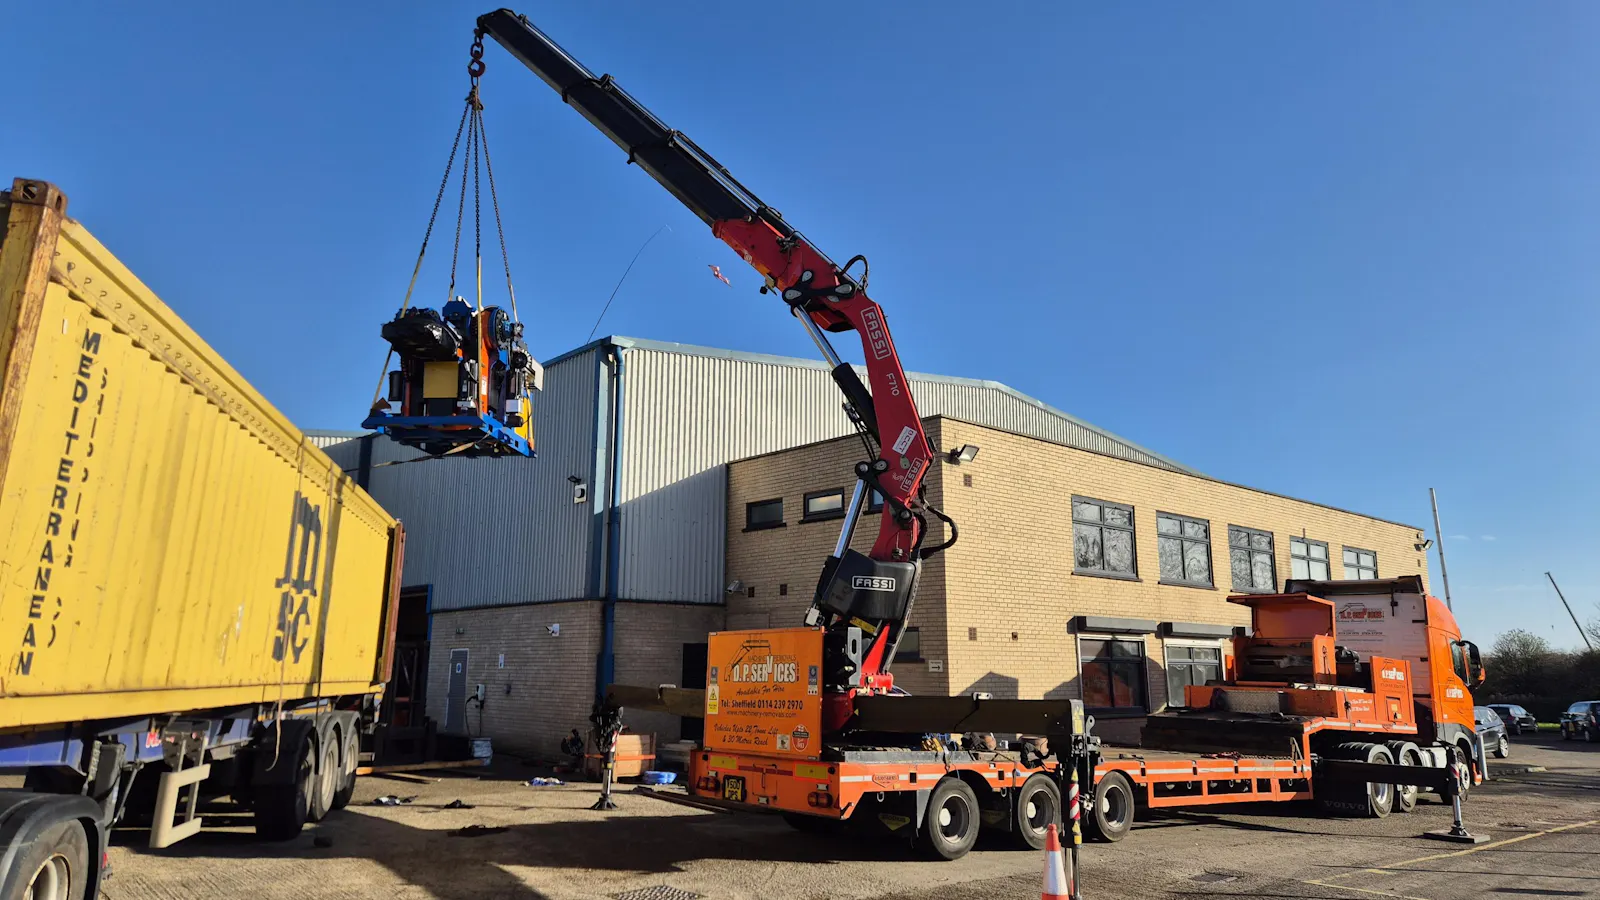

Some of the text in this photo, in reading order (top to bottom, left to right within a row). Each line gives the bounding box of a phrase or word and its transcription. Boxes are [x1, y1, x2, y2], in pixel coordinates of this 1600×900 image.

[865, 311, 888, 355] FASSI
[886, 372, 900, 396] F710
[902, 460, 921, 490] FASSI
[15, 327, 102, 676] MEDITERRANEAN
[855, 578, 893, 589] FASSI
[751, 655, 796, 682] SERVICES
[736, 684, 785, 696] Available For Hire
[721, 699, 730, 708] Tel:
[731, 699, 757, 709] Sheffield
[757, 699, 773, 709] 0114
[774, 699, 786, 709] 239
[787, 700, 804, 710] 2970
[754, 736, 768, 746] Reach
[1323, 799, 1366, 811] VOLVO
